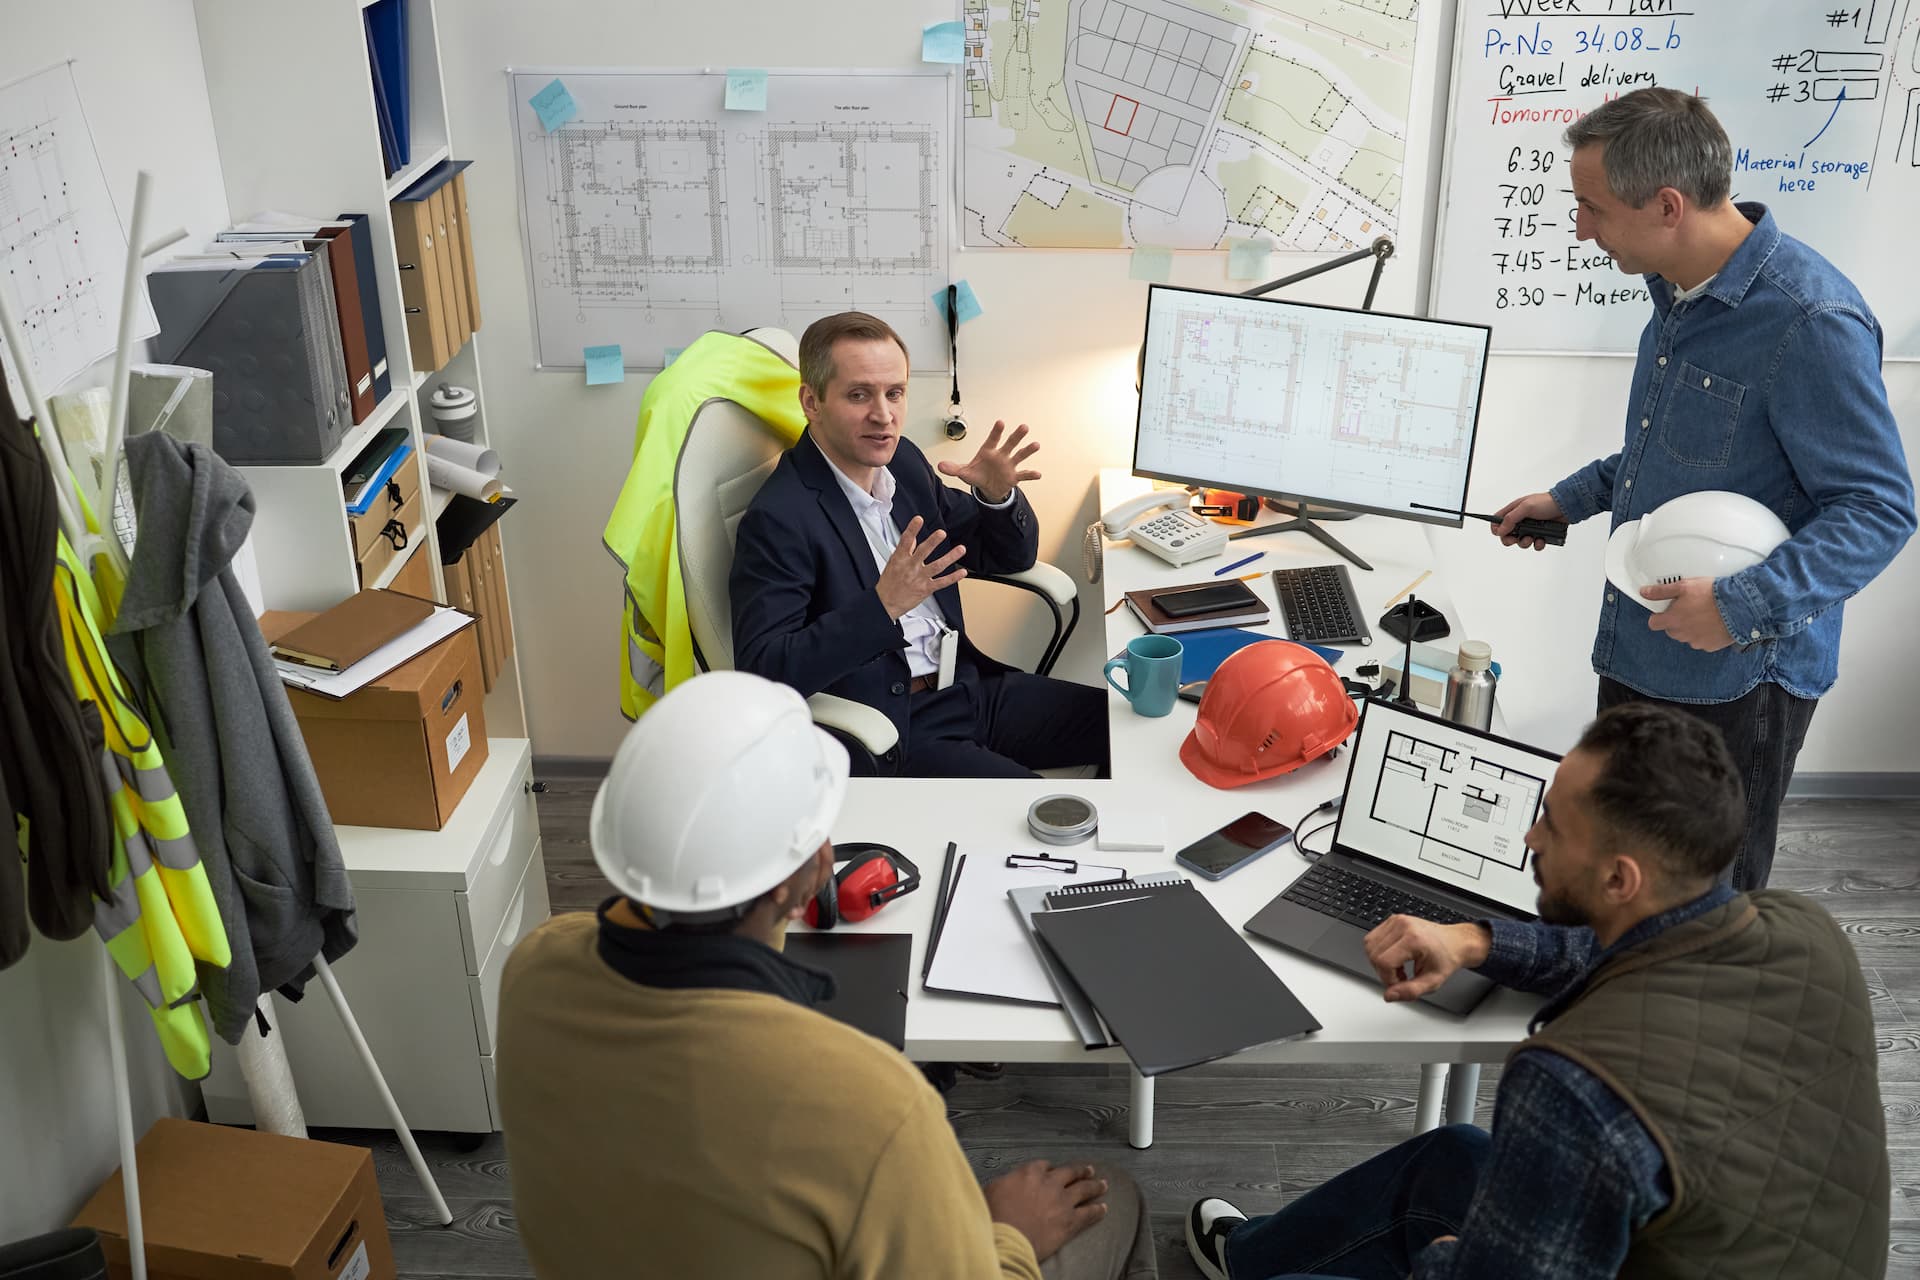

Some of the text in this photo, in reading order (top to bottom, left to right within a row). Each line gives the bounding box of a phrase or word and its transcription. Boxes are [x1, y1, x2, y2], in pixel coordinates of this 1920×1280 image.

[1825, 8, 1862, 29] #1
[1771, 49, 1816, 74] #2
[1499, 61, 1658, 96] Gravel delivery
[1734, 148, 1869, 180] Material storage
[1778, 175, 1816, 193] here
[1495, 286, 1546, 310] 8.30
